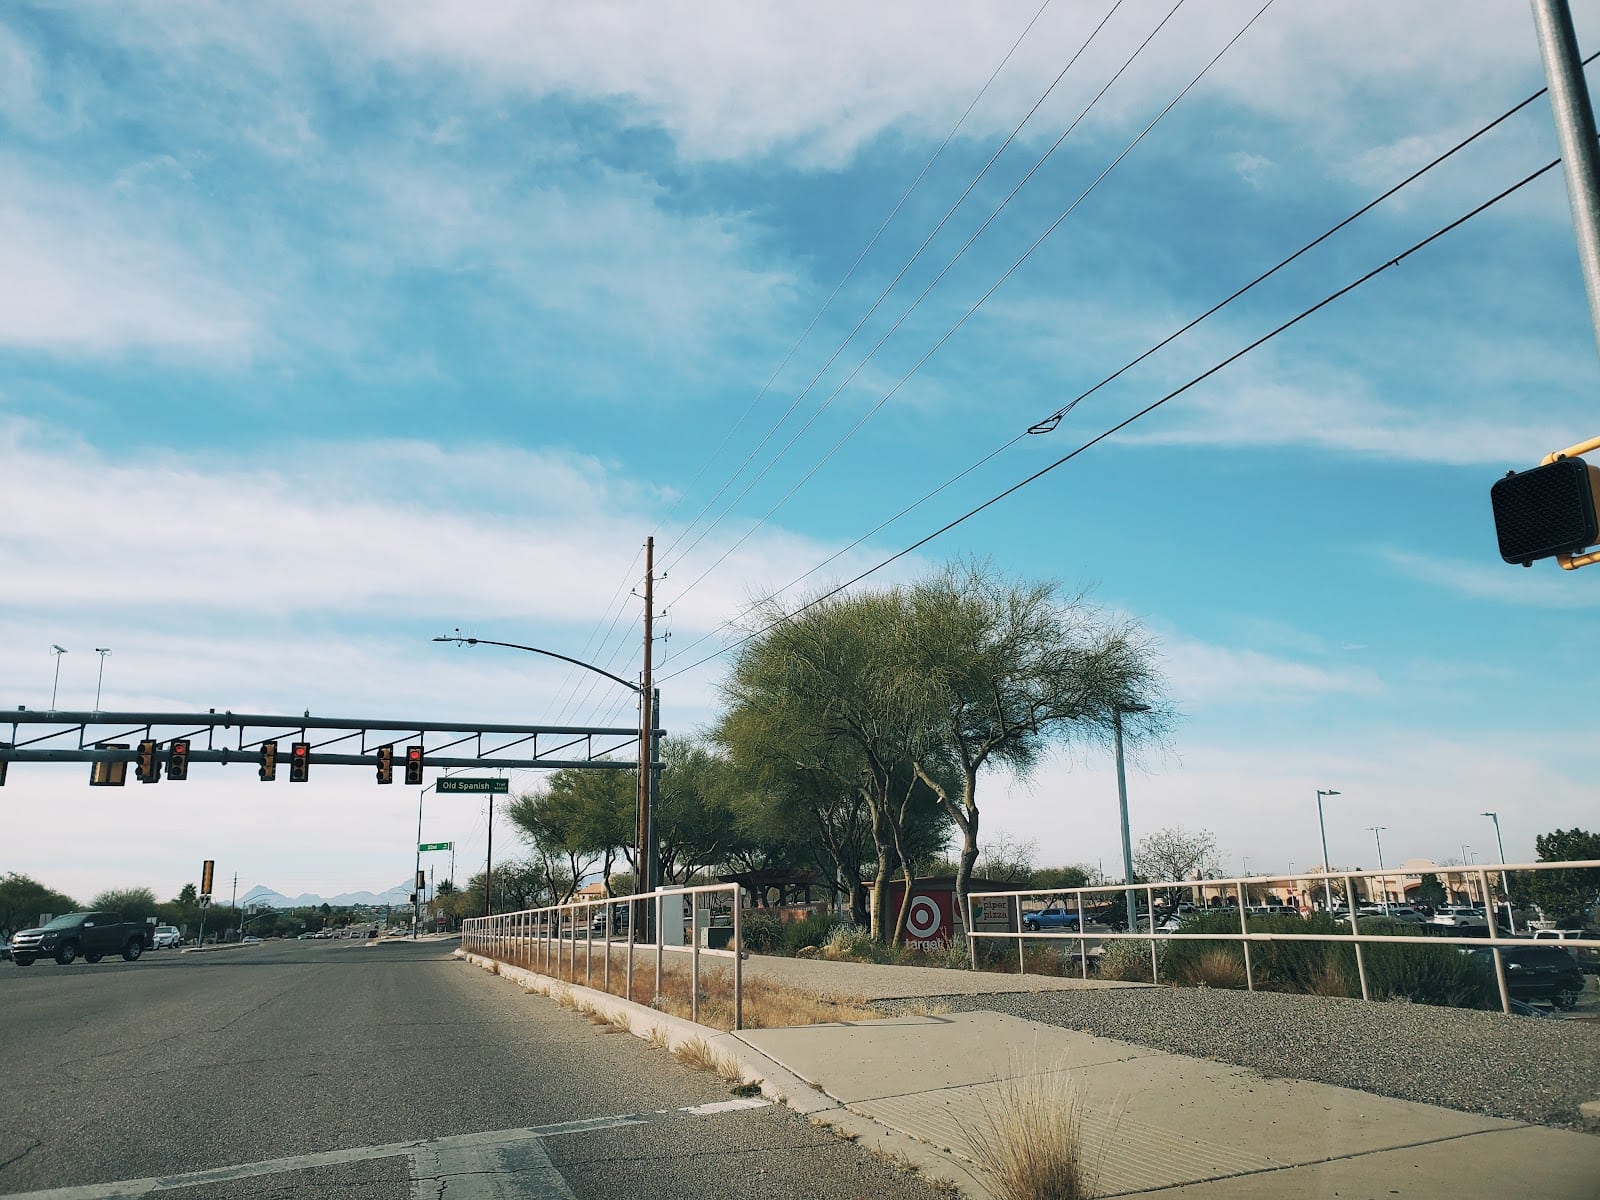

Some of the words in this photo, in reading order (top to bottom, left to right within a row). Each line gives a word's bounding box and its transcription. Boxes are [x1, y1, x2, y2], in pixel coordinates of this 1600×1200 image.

[442, 781, 457, 790] Old
[458, 782, 490, 791] Spanish
[983, 901, 1007, 910] piper
[983, 911, 1007, 920] pizza
